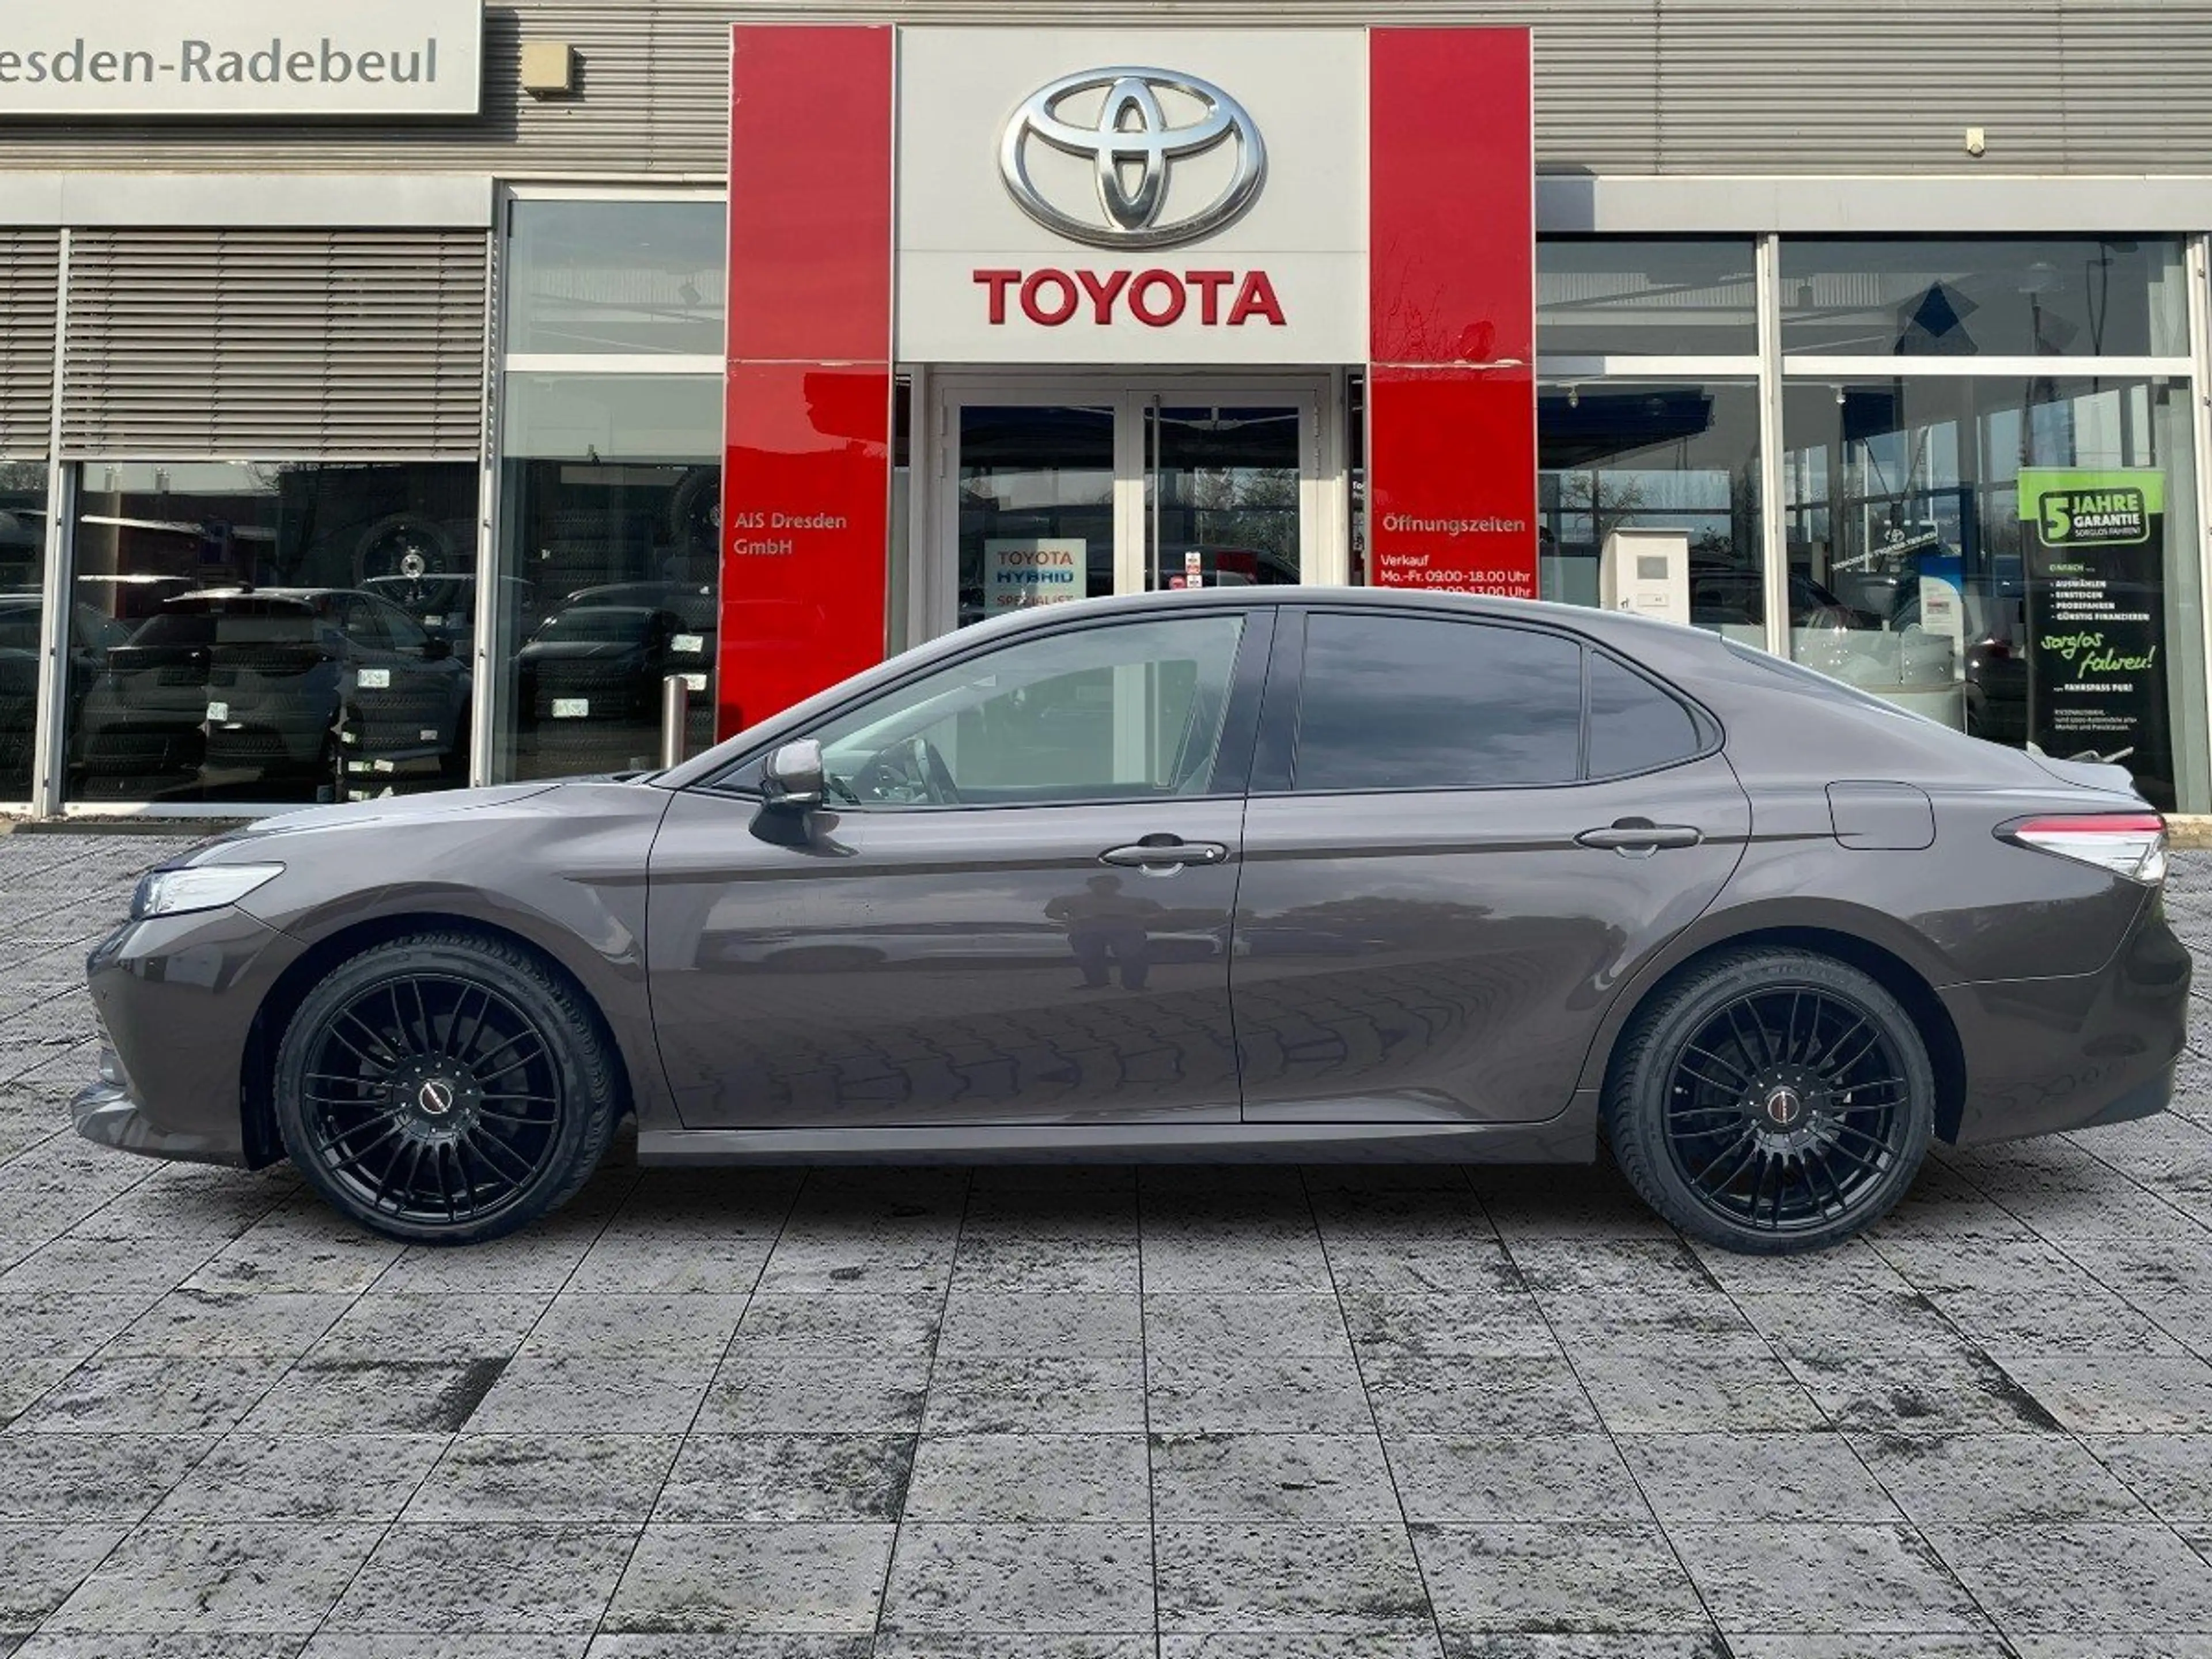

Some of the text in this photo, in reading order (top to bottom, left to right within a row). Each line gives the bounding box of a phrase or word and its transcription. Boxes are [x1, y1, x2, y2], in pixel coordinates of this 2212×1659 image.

[973, 268, 1287, 327] TOYOTA
[771, 512, 847, 528] Dresden
[1382, 512, 1525, 536] Öffnungszeiten
[2046, 494, 2139, 539] 5 JAHRE
[2074, 513, 2141, 528] GARANTIE
[733, 538, 793, 555] GmbH
[997, 550, 1074, 566] TOYOTA
[1380, 554, 1430, 567] Verkauf
[997, 570, 1074, 584] HYBRID
[1508, 570, 1531, 582] Uhr
[2056, 612, 2150, 621] GÜNSTIG FINANZIEREN
[2040, 631, 2104, 660] sorglos
[2077, 645, 2156, 679] fahren!
